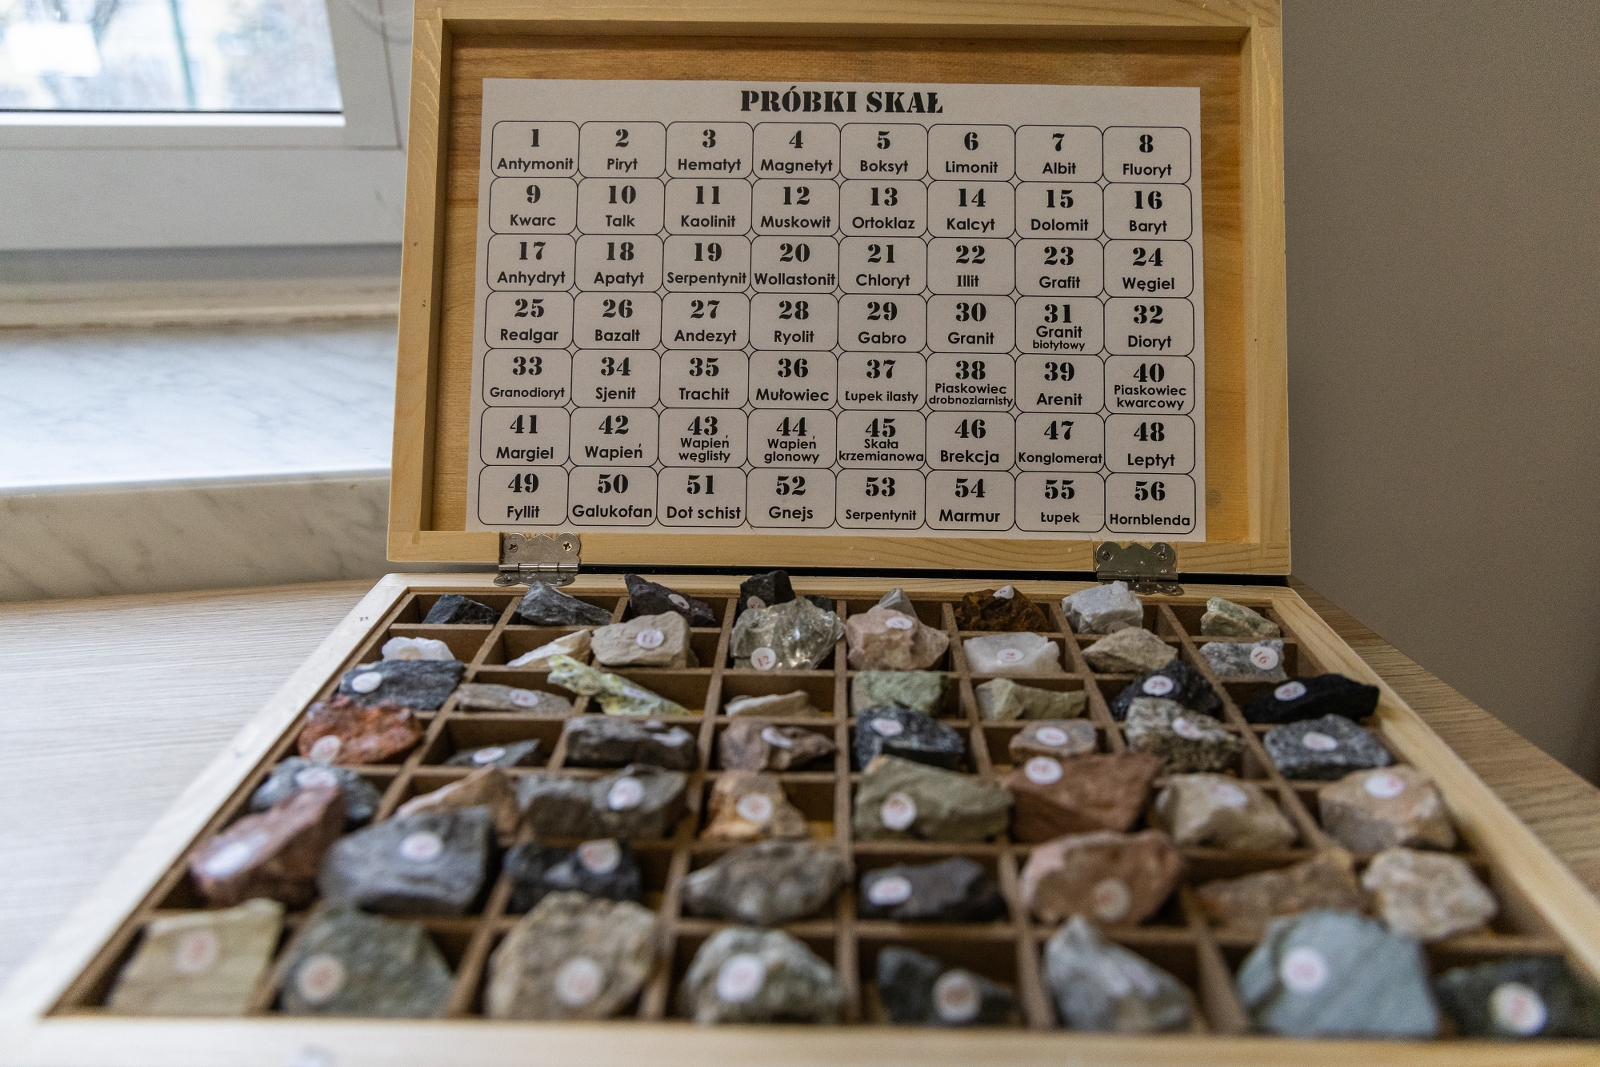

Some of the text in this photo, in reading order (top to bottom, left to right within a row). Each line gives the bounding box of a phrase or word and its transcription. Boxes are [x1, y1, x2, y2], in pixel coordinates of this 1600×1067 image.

[741, 86, 942, 113] PRÓBKI SKAŁ
[531, 129, 539, 147] 1
[616, 129, 629, 147] 2
[702, 129, 716, 148] 3
[789, 130, 803, 148] 4
[877, 131, 890, 149] 5
[964, 132, 978, 150] 6
[1052, 133, 1064, 152] 7
[1139, 134, 1154, 153] 8
[497, 158, 573, 172] Antymonit
[607, 158, 638, 172] Piryt
[678, 159, 741, 173] Hematyt
[761, 159, 832, 174] Magnetyt
[860, 160, 908, 175] Boksyt
[946, 161, 998, 173] Limonit
[1042, 162, 1076, 174] Albit
[1123, 164, 1172, 178] Fluoryt
[526, 185, 540, 203] 9
[609, 186, 636, 204] 10
[696, 186, 720, 204] 11
[783, 186, 810, 205] 12
[871, 187, 898, 206] 13
[959, 188, 986, 207] 14
[1046, 190, 1073, 208] 15
[1135, 191, 1162, 209] 16
[510, 214, 555, 226] Kwarc
[606, 215, 635, 226] Talk
[681, 215, 736, 227] Kaolinit
[761, 216, 831, 228] Muskowit
[852, 217, 915, 229] Ortoklaz
[947, 218, 995, 233] Kalcyt
[1031, 219, 1088, 231] Dolomit
[1130, 220, 1167, 235] Baryt
[519, 242, 546, 260] 17
[607, 242, 634, 260] 18
[694, 243, 722, 261] 19
[780, 243, 810, 262] 20
[868, 244, 895, 263] 21
[956, 245, 985, 264] 22
[1044, 246, 1074, 265] 23
[1133, 247, 1163, 266] 24
[497, 271, 565, 286] Anhydryt
[594, 272, 644, 287] Apatyt
[667, 272, 746, 286] Serpentynit
[754, 273, 835, 285] Wollastonit
[856, 274, 910, 289] Chloryt
[957, 275, 979, 287] Illit
[1039, 276, 1080, 288] Grafit
[1122, 277, 1174, 292] Węgiel
[515, 299, 544, 318] 25
[602, 299, 633, 318] 26
[690, 300, 720, 318] 27
[779, 301, 809, 320] 28
[867, 302, 897, 320] 29
[956, 302, 986, 322] 30
[1044, 304, 1072, 323] 31
[1134, 305, 1163, 324] 32
[501, 328, 558, 343] Realgar
[595, 329, 640, 341] Bazalt
[674, 330, 736, 344] Andezyt
[774, 330, 814, 345] Ryolit
[858, 332, 906, 344] Gabro
[948, 332, 994, 344] Granit
[1036, 326, 1082, 338] Granit
[1033, 340, 1085, 351] biotytowy
[1128, 335, 1172, 350] Dioryt
[513, 356, 542, 375] 33
[601, 357, 631, 376] 34
[689, 358, 719, 376] 35
[778, 358, 808, 378] 36
[866, 360, 896, 378] 37
[956, 360, 986, 380] 38
[1044, 362, 1074, 381] 39
[1133, 363, 1164, 382] 40
[490, 387, 565, 400] Granodioryt
[596, 387, 636, 402] Sjenit
[679, 388, 729, 400] Trachit
[756, 388, 829, 401] Mułowiec
[935, 383, 1006, 394] Piaskowiec
[1114, 384, 1186, 396] Piaskowiec
[845, 391, 918, 404] Łupek ilasty
[929, 396, 1013, 407] drobnoziarnisty
[1036, 393, 1082, 405] Arenit
[1117, 397, 1184, 410] kwarcowy
[510, 415, 538, 434] 41
[598, 415, 628, 434] 42
[688, 416, 718, 435] 43
[776, 417, 807, 436] 44
[866, 418, 896, 437] 45
[955, 419, 986, 438] 46
[1044, 421, 1074, 440] 47
[1134, 422, 1164, 441] 48
[680, 435, 729, 450] Wapień
[768, 436, 816, 451] Wapień
[864, 439, 898, 448] Skała
[496, 447, 553, 462] Margiel
[585, 444, 642, 461] Wapień
[679, 450, 730, 463] węglisty
[764, 451, 819, 464] glonowy
[839, 450, 924, 461] krzemianowa
[941, 450, 999, 466] Brekcja
[1019, 452, 1102, 465] Konglomerat
[1128, 454, 1175, 469] Leptyt
[508, 474, 539, 493] 49
[598, 474, 628, 493] 50
[687, 475, 714, 494] 51
[776, 476, 806, 496] 52
[866, 477, 895, 496] 53
[955, 478, 985, 498] 54
[1045, 480, 1074, 499] 55
[1135, 481, 1165, 501] 56
[507, 506, 540, 521] Fyllit
[572, 505, 652, 518] Galukofan
[667, 506, 741, 519] Dot schist
[769, 506, 813, 522] Gnejs
[846, 509, 916, 522] Serpentynit
[939, 509, 1000, 522] Marmur
[1041, 512, 1080, 524] Łupek
[1110, 514, 1190, 526] Hornblenda
[758, 654, 770, 668] 12
[1254, 650, 1269, 664] 16
